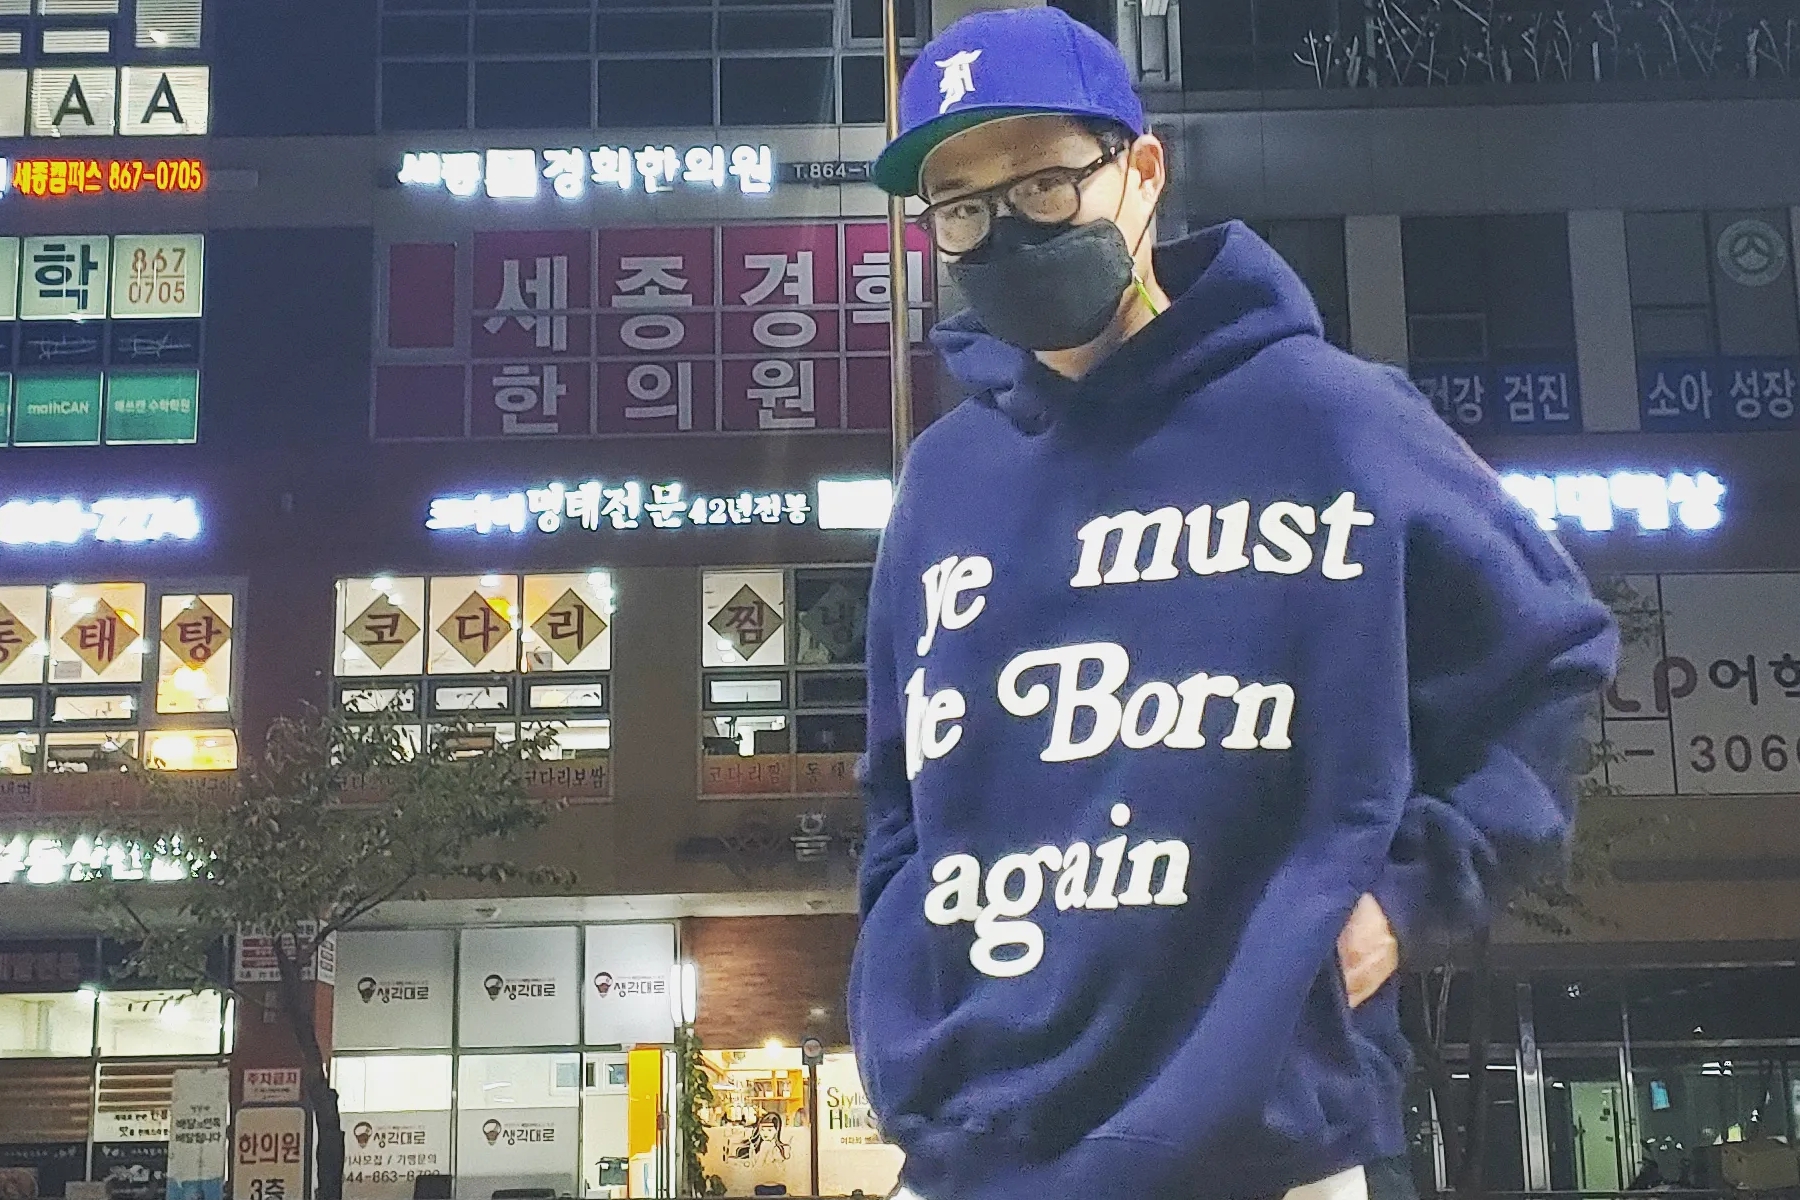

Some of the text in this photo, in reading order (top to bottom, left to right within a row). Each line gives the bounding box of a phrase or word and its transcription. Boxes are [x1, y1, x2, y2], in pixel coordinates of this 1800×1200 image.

[13, 159, 102, 195] 세종캠퍼스
[108, 159, 202, 191] 867-0705
[541, 145, 772, 198] 경희한의원
[793, 163, 873, 179] T.864-1
[33, 243, 98, 310] 학
[131, 248, 186, 273] 867
[129, 282, 185, 303] 0705
[1504, 373, 1571, 423] 검진
[1647, 368, 1797, 420] 소아 성장
[916, 491, 1375, 656] ye must
[997, 641, 1295, 762] Born
[924, 803, 1190, 978] again
[376, 987, 430, 1004] 생각대로
[503, 982, 556, 1000] 생각대로
[613, 980, 666, 998] 생각대로
[239, 1132, 300, 1164] 한의원
[373, 1131, 426, 1149] 생각대로
[502, 1127, 555, 1145] 생각대로
